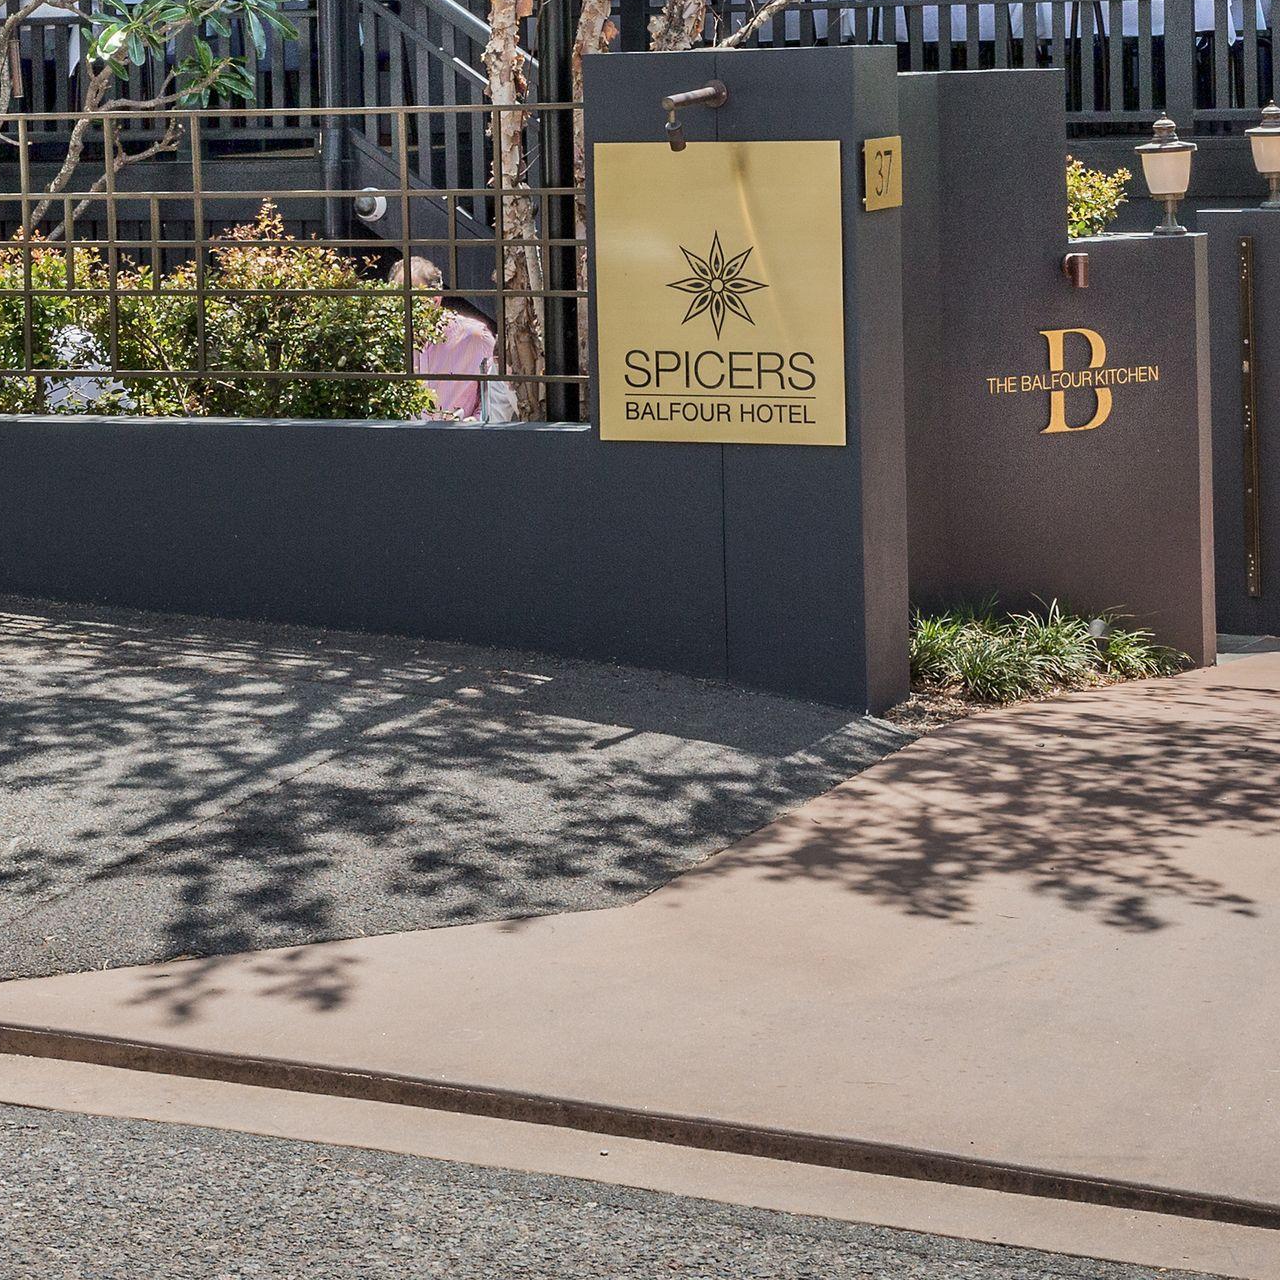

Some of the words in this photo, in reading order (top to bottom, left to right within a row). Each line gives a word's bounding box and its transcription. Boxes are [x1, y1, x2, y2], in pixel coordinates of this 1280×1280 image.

[874, 149, 894, 197] 37
[624, 349, 817, 391] SPICERS
[986, 375, 1018, 395] THE
[1021, 370, 1093, 392] BALFOUR
[1095, 365, 1160, 386] KITCHEN
[625, 401, 732, 423] BALFOUR
[740, 403, 817, 425] HOTEL
